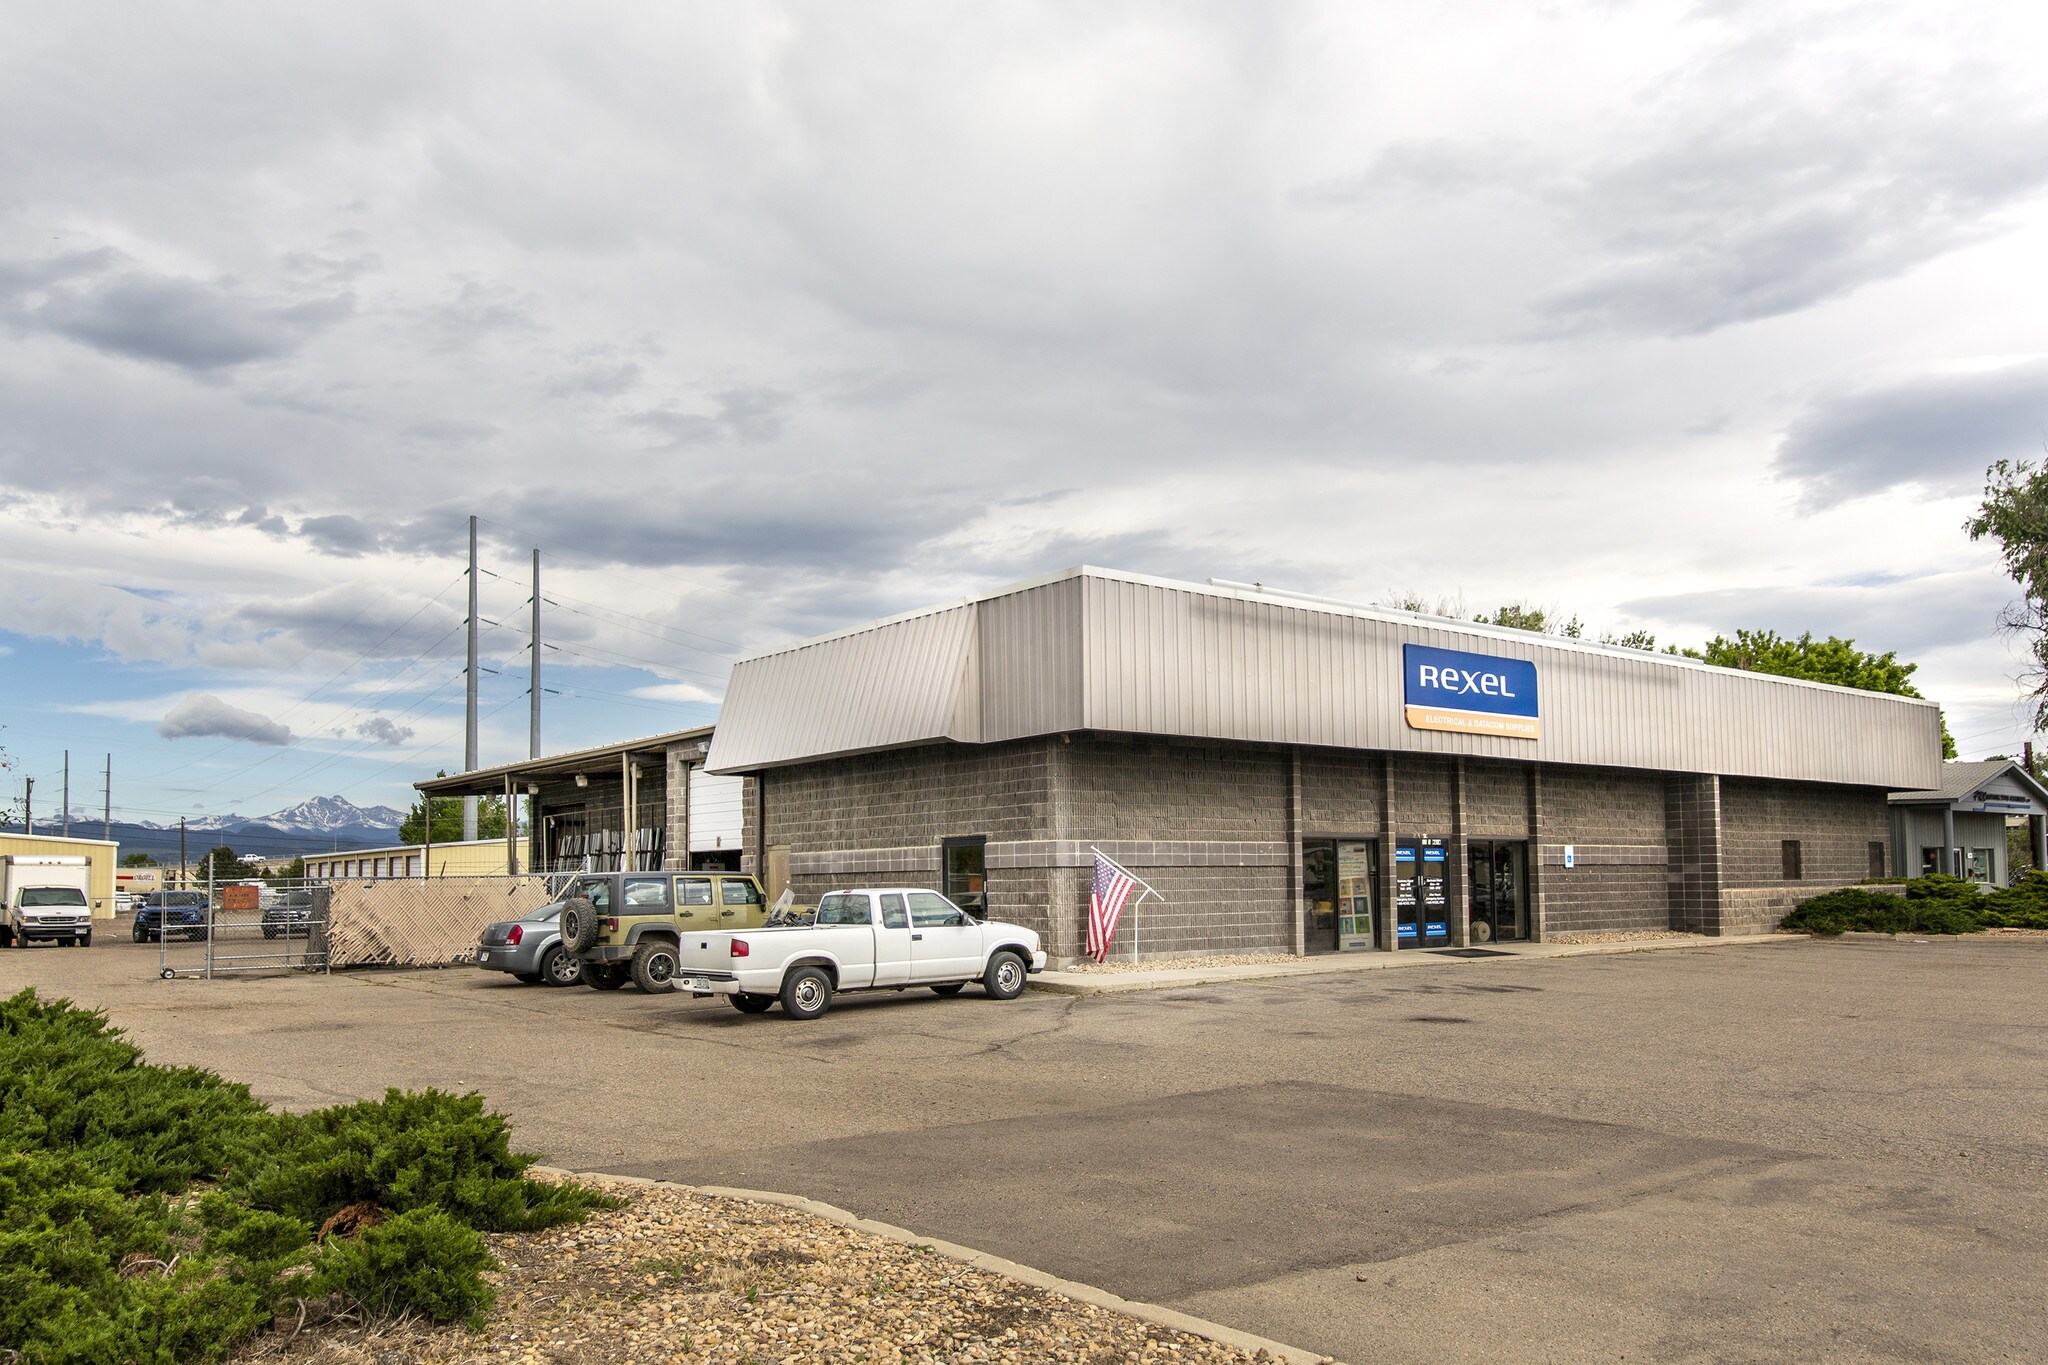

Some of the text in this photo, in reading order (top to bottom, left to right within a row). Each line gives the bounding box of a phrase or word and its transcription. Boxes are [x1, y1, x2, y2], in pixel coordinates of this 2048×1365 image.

[1426, 715, 1536, 733] ELECTRICAL & DATACOM SUPPLIES
